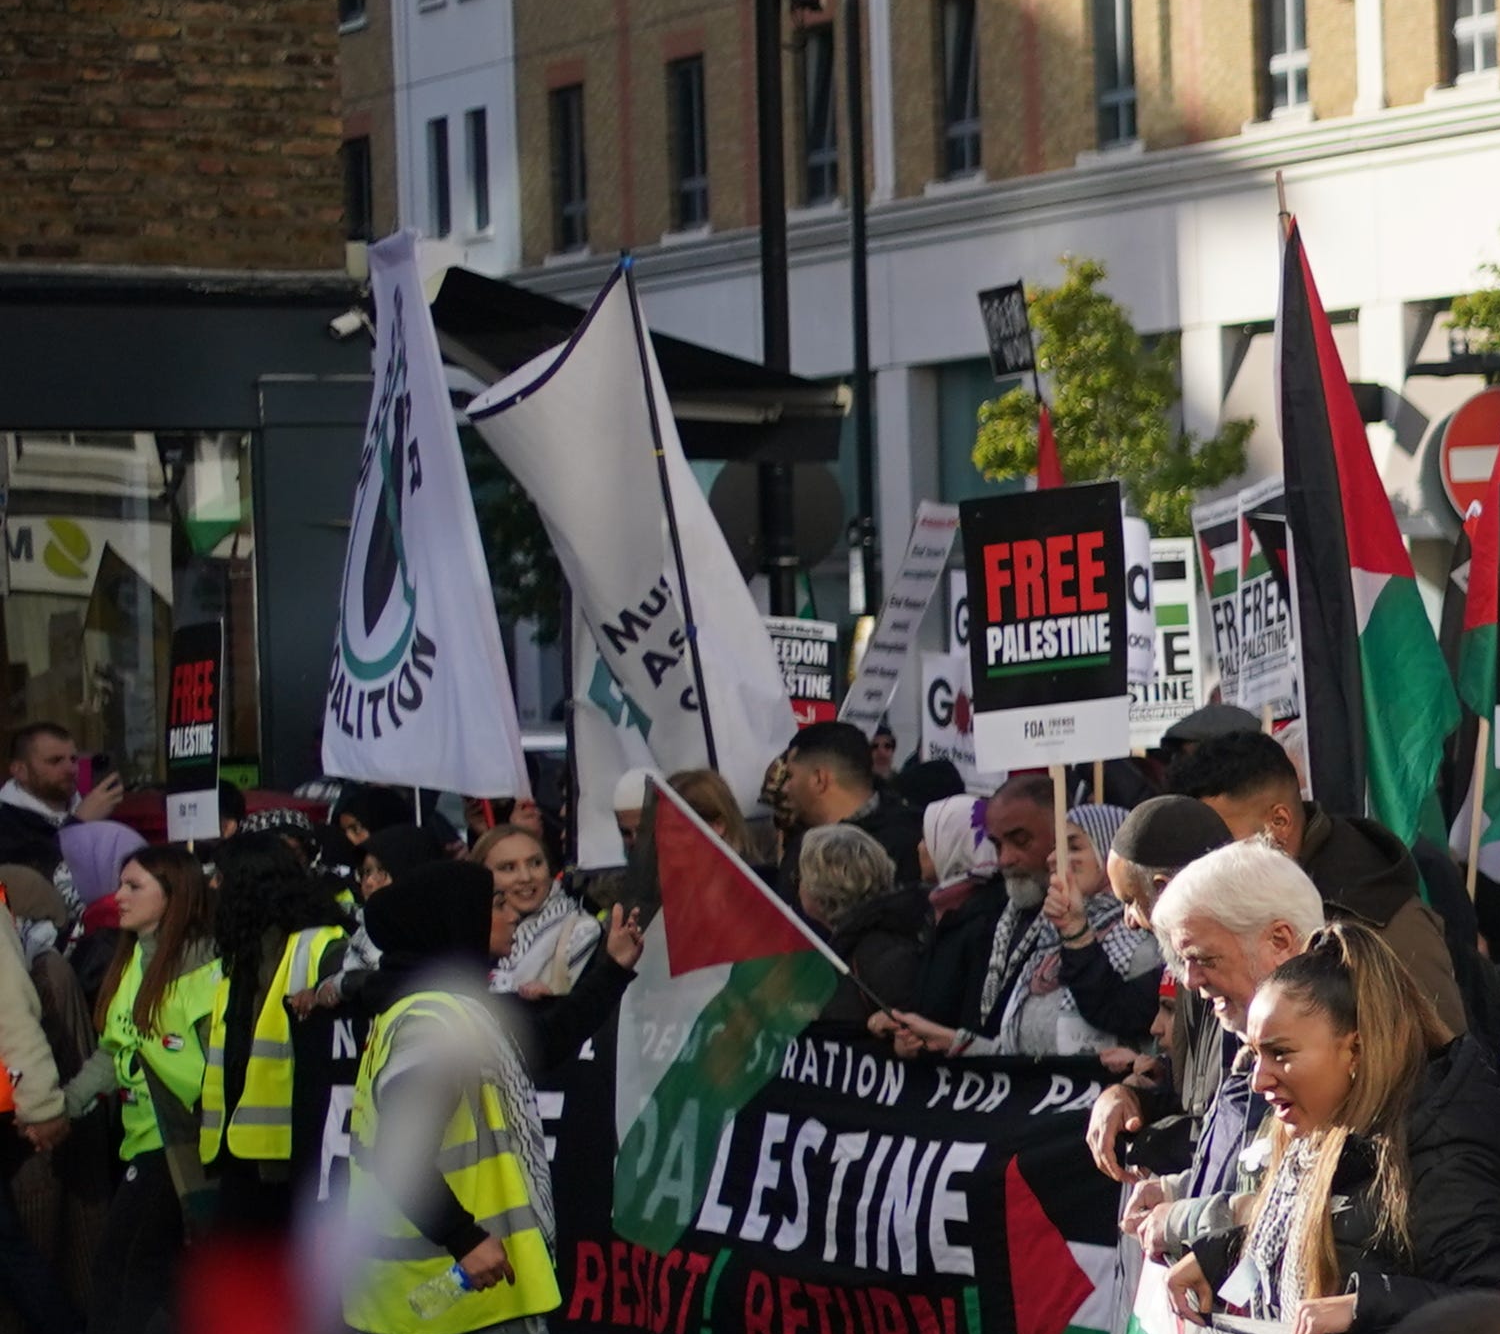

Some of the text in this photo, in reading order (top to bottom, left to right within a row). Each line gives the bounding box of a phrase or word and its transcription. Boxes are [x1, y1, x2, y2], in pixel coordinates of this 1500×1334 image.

[982, 530, 1109, 623] FREE
[987, 611, 1111, 666] PALESTINE
[1241, 625, 1289, 665] PALESTINE
[172, 659, 215, 727] FREE
[169, 721, 215, 760] PALESTINE
[1024, 720, 1045, 740] FOA
[927, 1066, 1012, 1114] FOR
[613, 1097, 987, 1277] PALESTINE
